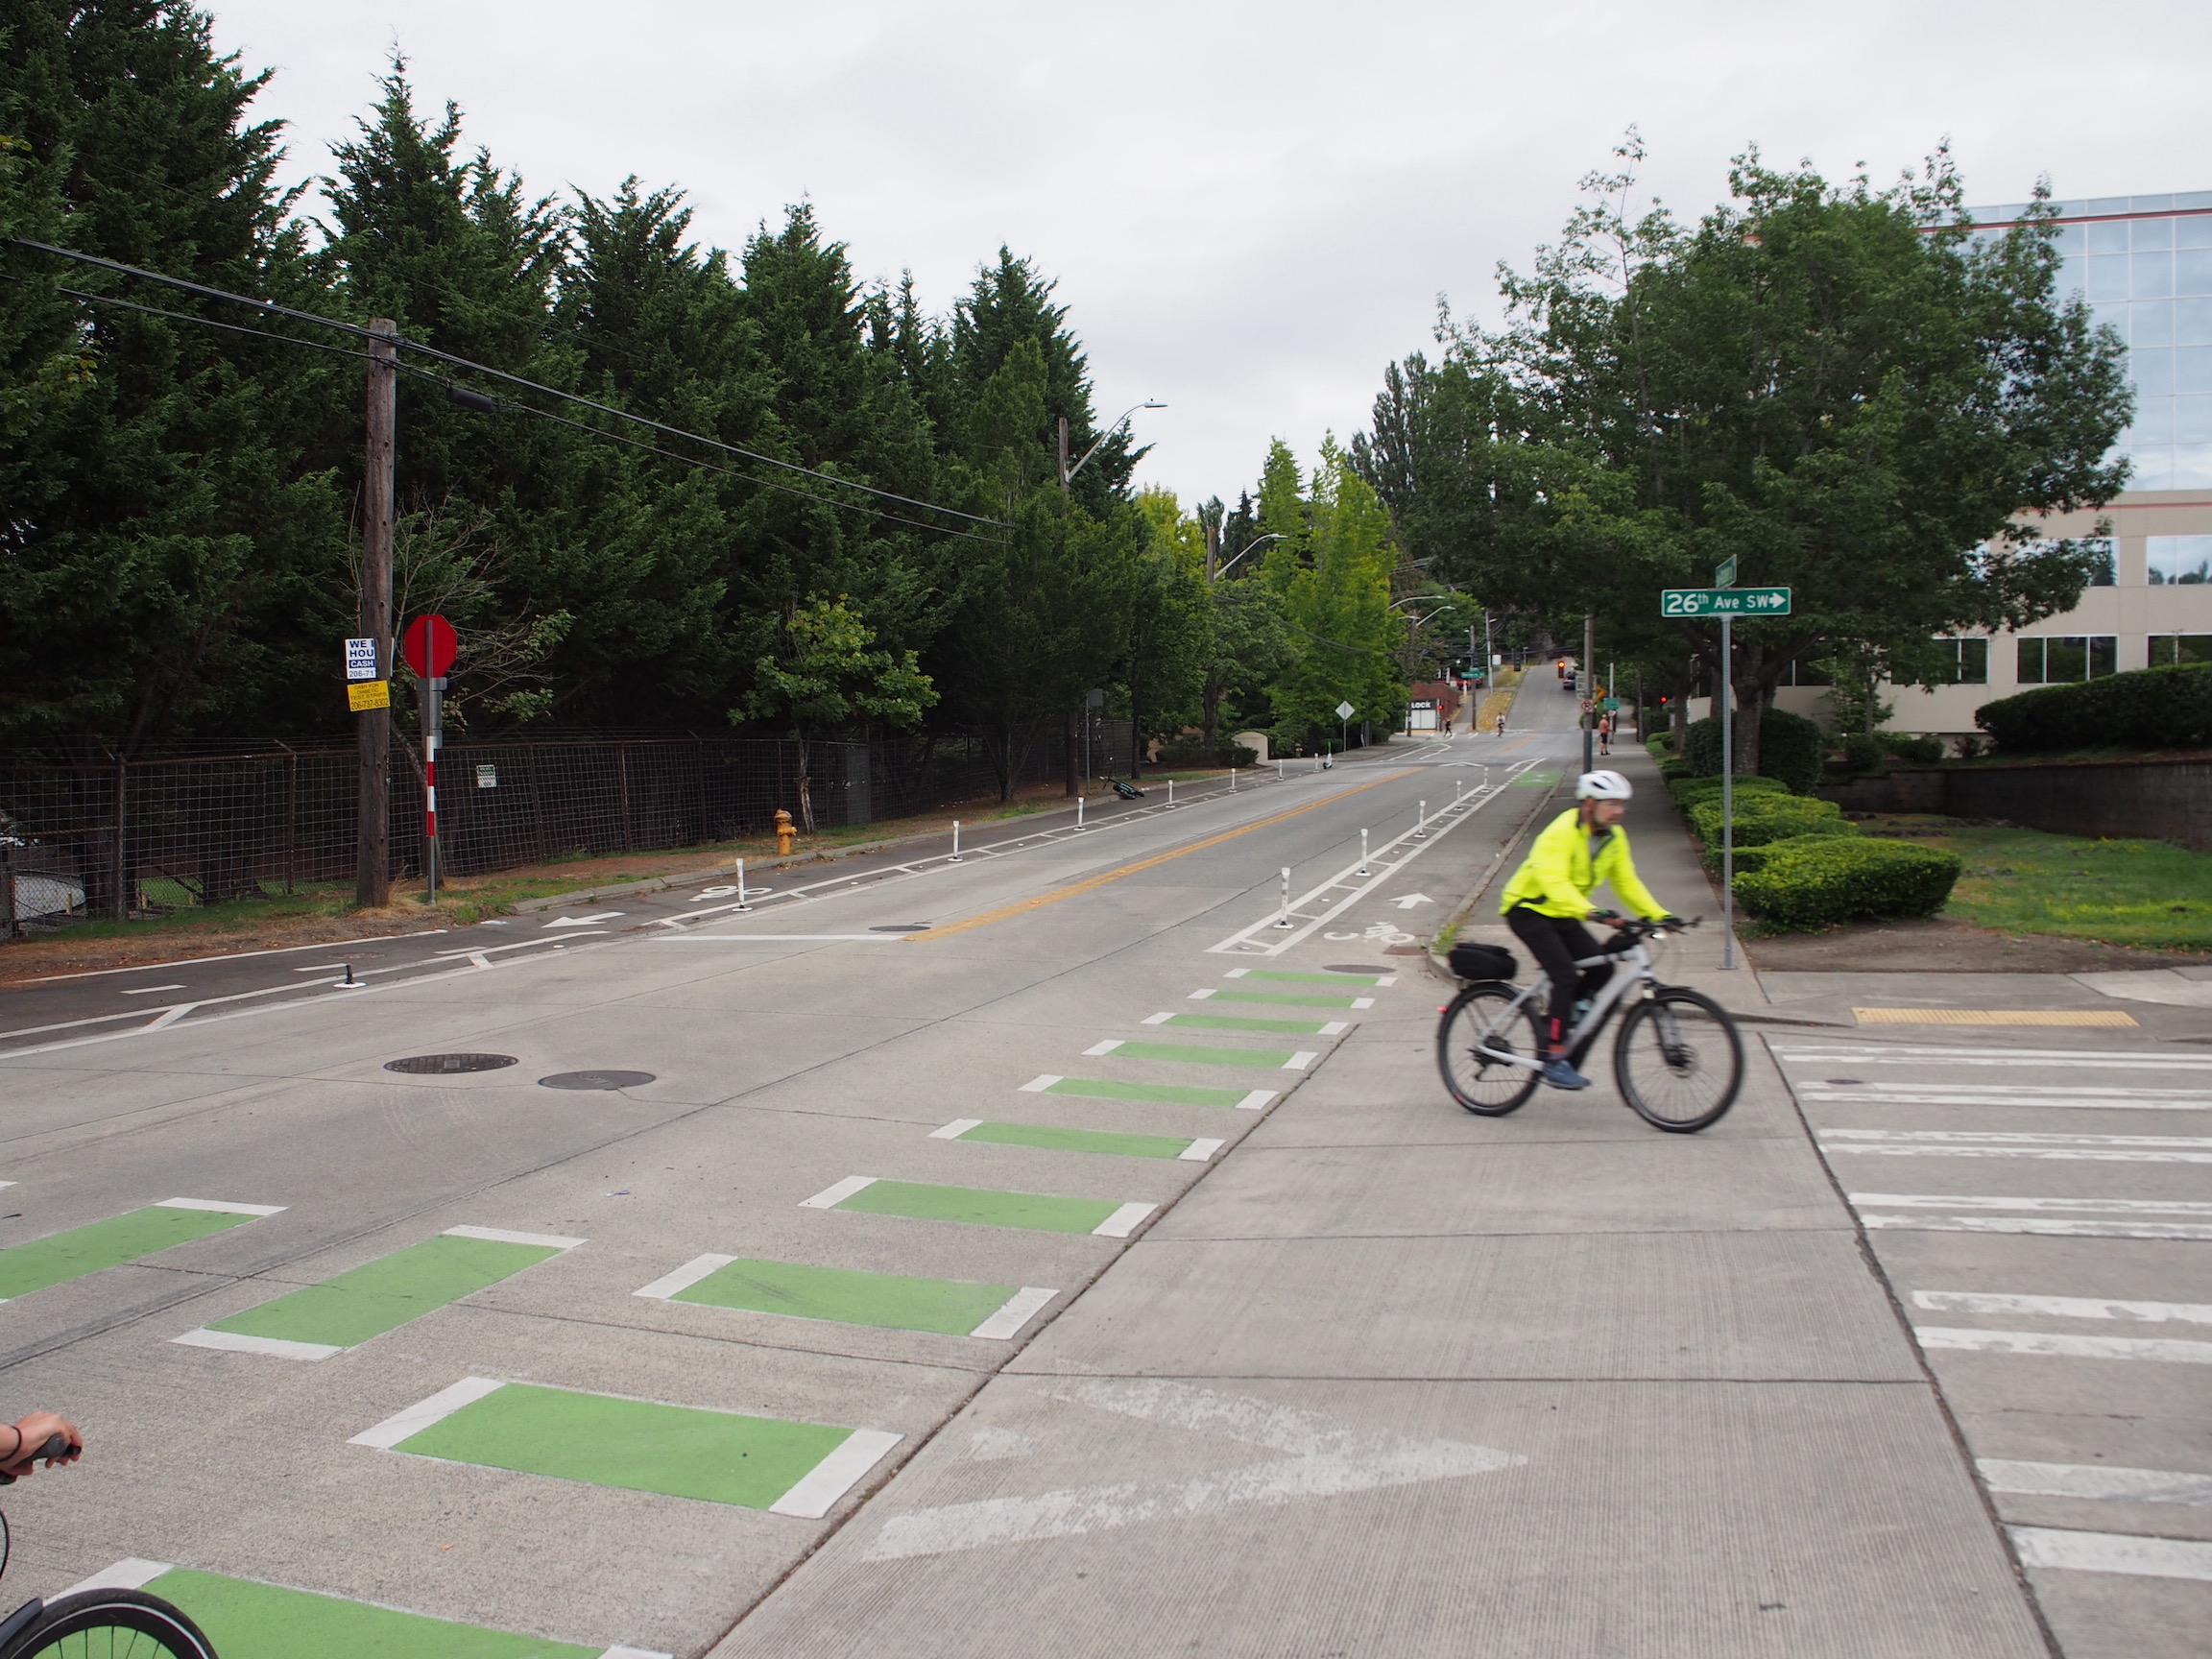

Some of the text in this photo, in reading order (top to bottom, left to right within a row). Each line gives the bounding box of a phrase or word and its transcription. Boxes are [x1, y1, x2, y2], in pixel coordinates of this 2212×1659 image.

[1667, 593, 1769, 613] 26th Ave SW
